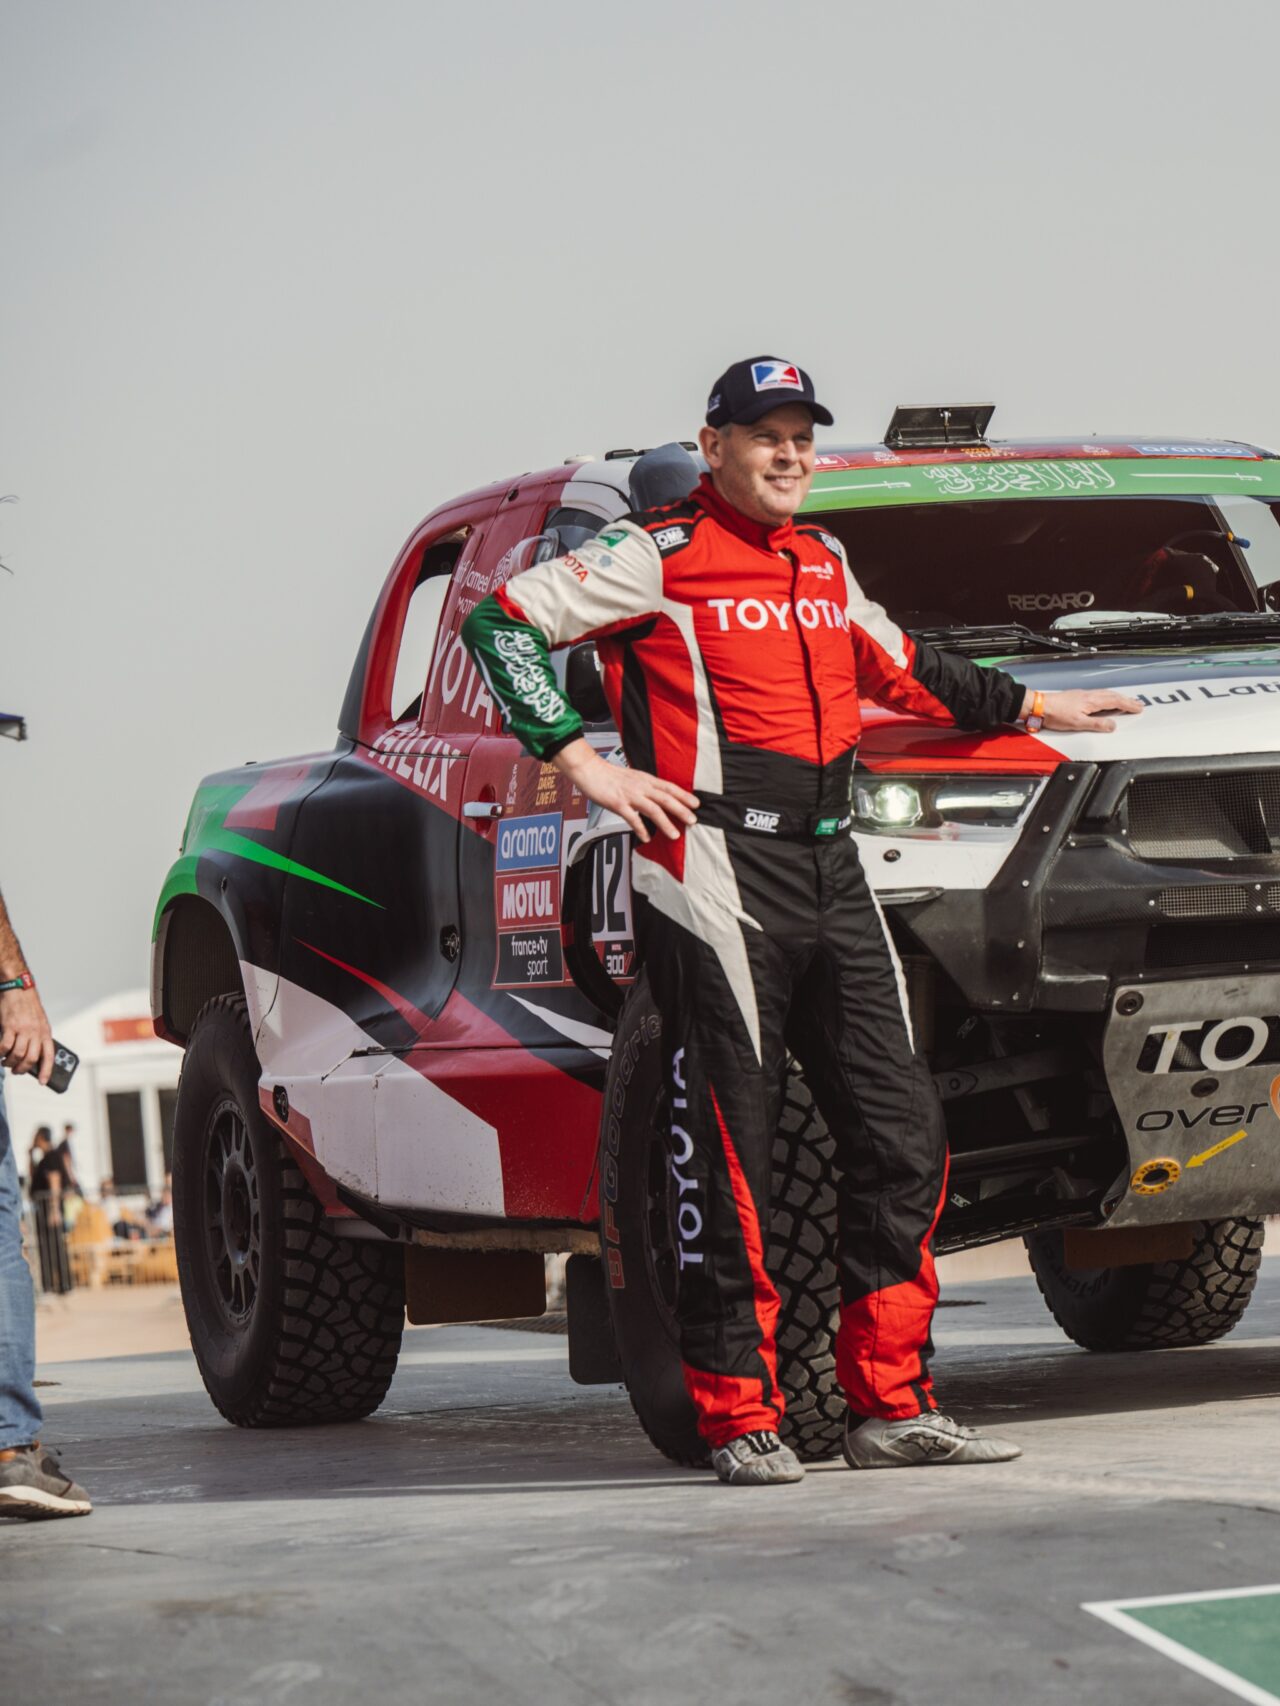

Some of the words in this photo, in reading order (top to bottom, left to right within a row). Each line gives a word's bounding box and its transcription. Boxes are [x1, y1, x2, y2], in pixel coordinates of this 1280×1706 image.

[656, 528, 686, 547] OMP
[707, 598, 849, 632] TOYOTA
[1007, 591, 1095, 610] RECARO
[429, 624, 494, 728] YOTA
[1137, 689, 1192, 707] dul
[368, 726, 462, 801] HILUX
[744, 813, 780, 829] OMP
[502, 825, 556, 859] aramco
[569, 831, 628, 933] 02
[502, 880, 553, 919] MOTUL
[526, 959, 549, 982] sport
[606, 951, 633, 975] 300V
[1135, 1099, 1271, 1135] over
[603, 1014, 662, 1289] BFGoodric
